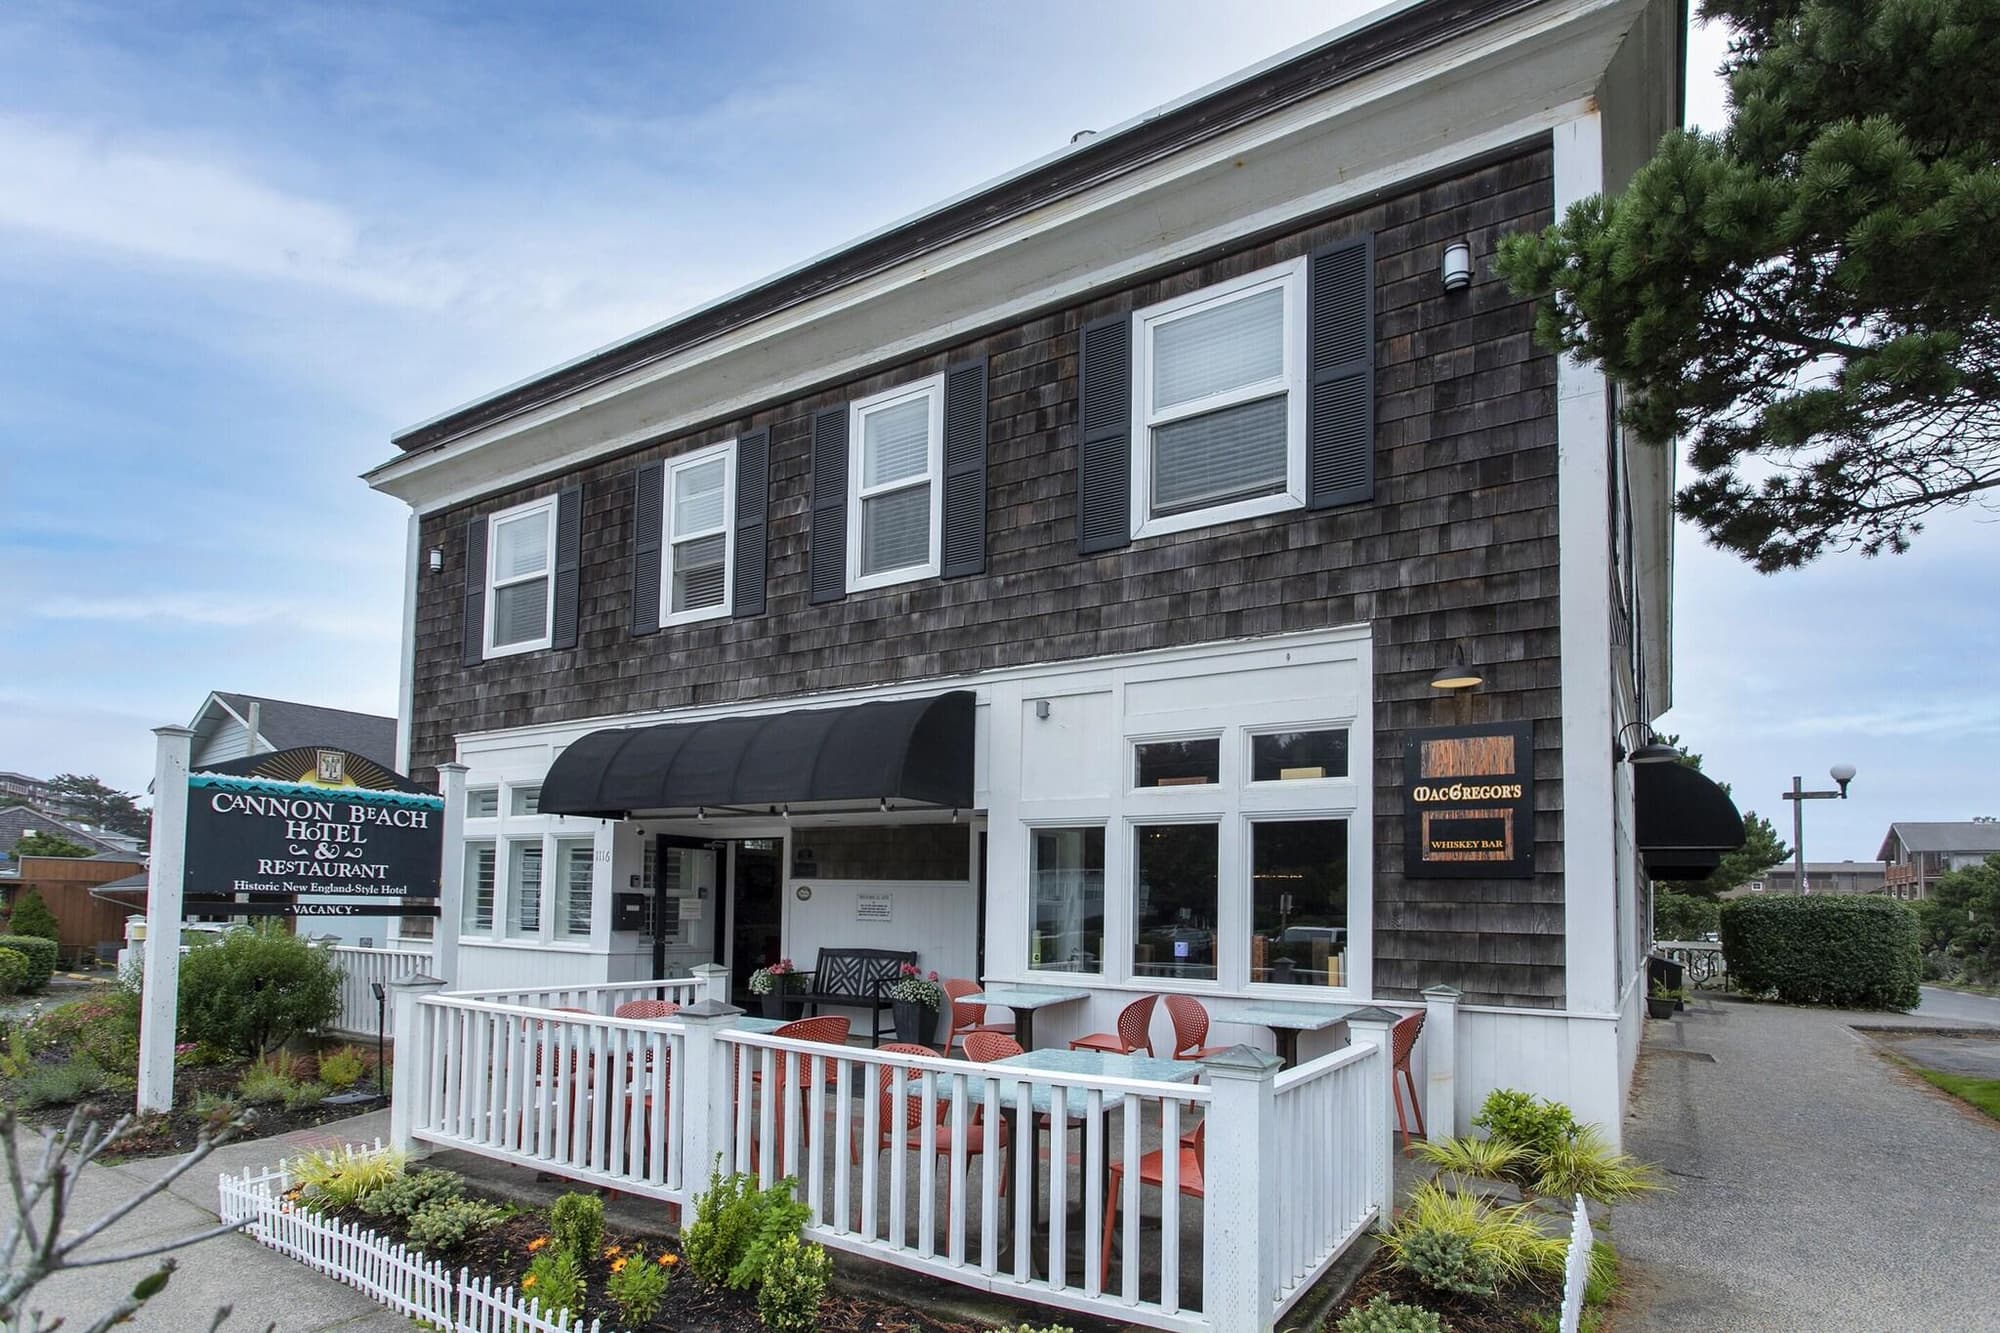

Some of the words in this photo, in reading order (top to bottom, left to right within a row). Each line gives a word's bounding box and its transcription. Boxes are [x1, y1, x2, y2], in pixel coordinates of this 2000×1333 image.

[1413, 782, 1522, 802] MACGREGOR'S
[211, 793, 335, 821] CANNON
[349, 804, 429, 829] BEACH
[285, 820, 368, 844] HOTEL
[314, 842, 340, 860] &
[1431, 840, 1480, 849] WHISKEY
[1481, 840, 1504, 849] BAR
[257, 859, 390, 879] RESTAURANT
[233, 880, 280, 892] Historic
[282, 882, 308, 892] New
[310, 882, 379, 895] England-Style
[381, 885, 408, 895] Hotel
